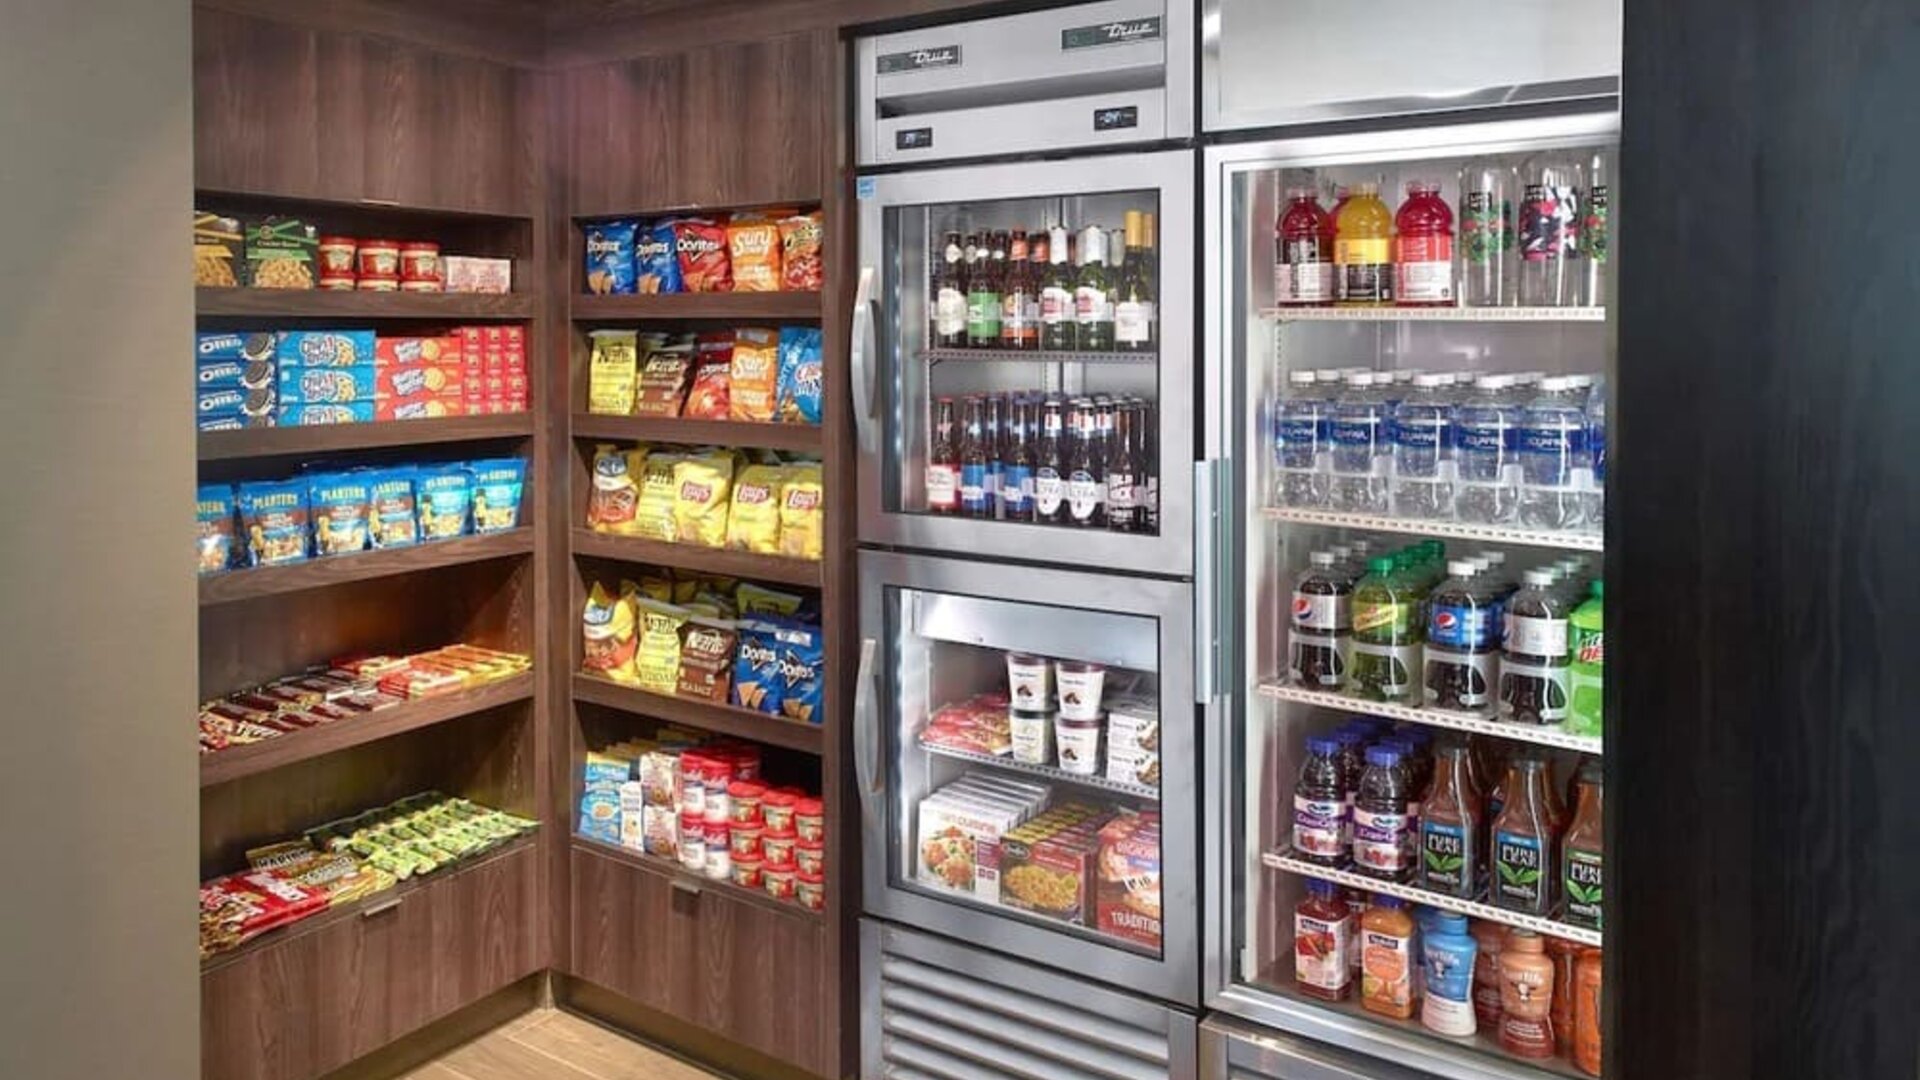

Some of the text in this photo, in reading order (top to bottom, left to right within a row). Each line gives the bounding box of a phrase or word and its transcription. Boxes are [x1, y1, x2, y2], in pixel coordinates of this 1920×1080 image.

[677, 239, 719, 252] Doritos
[199, 339, 242, 353] OREO
[199, 367, 242, 382] OREO
[199, 394, 242, 410] OREO
[252, 493, 299, 510] PLANTERS
[320, 487, 365, 503] PLANTERS
[742, 644, 776, 662] Doritos
[779, 660, 815, 679] Doritos
